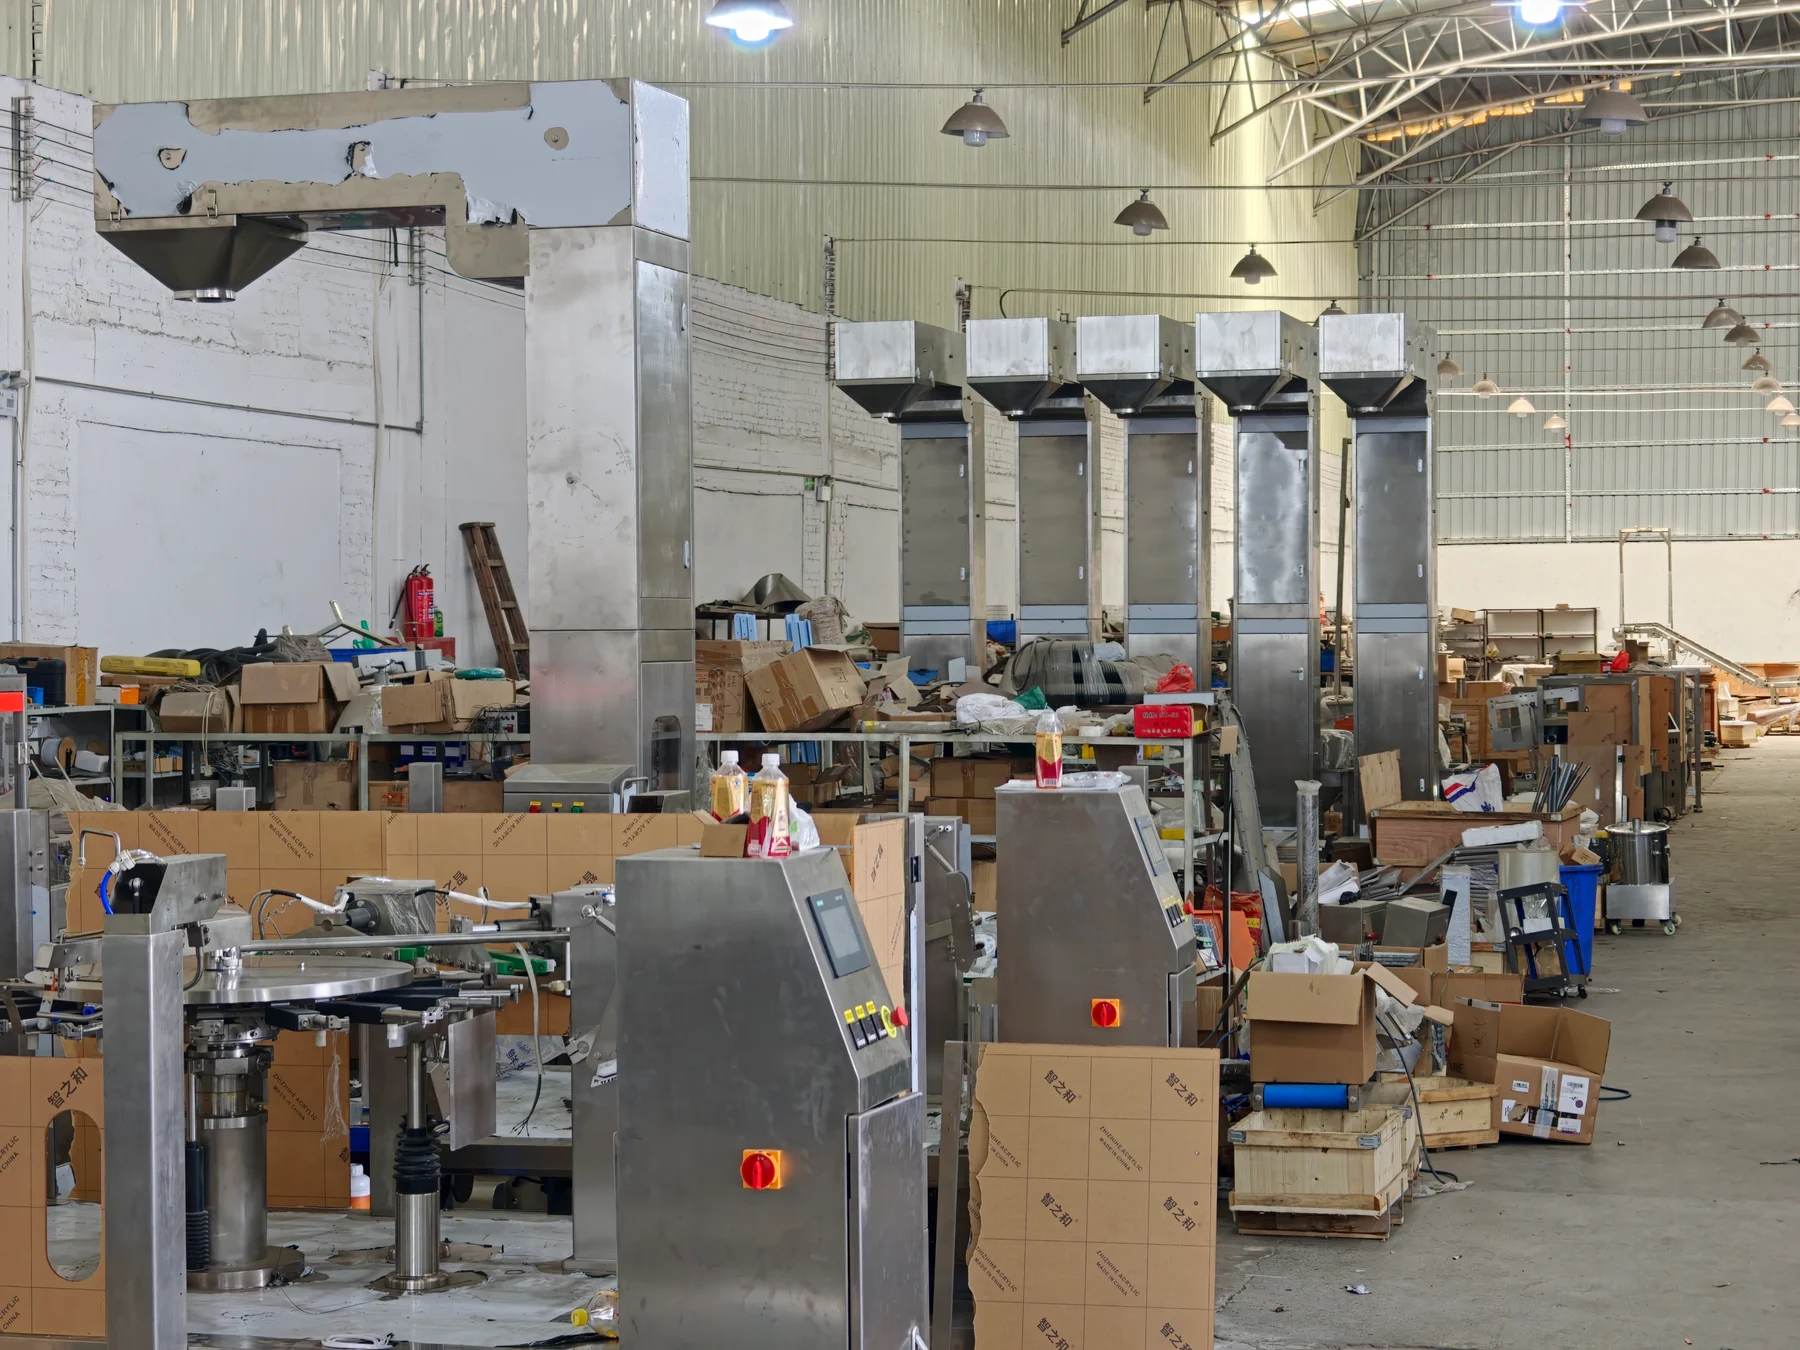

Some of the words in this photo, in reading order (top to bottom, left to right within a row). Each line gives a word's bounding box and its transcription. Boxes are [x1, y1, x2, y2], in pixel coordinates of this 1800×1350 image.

[148, 812, 171, 837] ZHIZHIHE
[170, 835, 191, 855] ACRYLI
[148, 823, 161, 839] MADE
[166, 842, 180, 855] CHIN
[269, 812, 292, 837] ZHIZHIHE
[291, 835, 314, 858] ACRYLIC
[269, 823, 282, 839] MADE
[286, 842, 301, 858] CHINA
[493, 818, 509, 834] CHINA
[493, 823, 516, 848] ACRYLIC
[623, 818, 639, 834] CHINA
[623, 824, 646, 848] ACRYLIC
[47, 1066, 88, 1109] 智之和
[273, 1073, 296, 1099] ZHIZHIHE
[295, 1097, 318, 1121] ACRYLIC
[273, 1085, 286, 1101] MADE
[290, 1105, 305, 1121] CHINA
[1044, 1069, 1077, 1104] 智之和
[1165, 1072, 1198, 1107] 智之和
[0, 1135, 19, 1159] RYLIC
[1, 1151, 19, 1170] CHINA
[995, 1151, 1009, 1168] CHINA
[1000, 1145, 1022, 1168] ACRYLIC
[1099, 1125, 1122, 1150] ZHIZHIHE
[1121, 1149, 1143, 1171] ACRYLIC
[1099, 1137, 1112, 1152] MADE
[1116, 1155, 1131, 1171] CHINA
[1040, 1192, 1073, 1227] 智之和
[1162, 1196, 1196, 1231] 智之和
[975, 1257, 988, 1272] MADE
[986, 1270, 992, 1278] IN
[991, 1276, 1005, 1292] CHINA
[996, 1269, 1018, 1292] ACRYLIC
[1096, 1250, 1119, 1274] ZHIZHIHE
[1118, 1273, 1140, 1297] ACRYLIC
[1096, 1261, 1110, 1277] MADE
[1113, 1280, 1128, 1297] CHINA
[2, 1311, 20, 1330] CHINA
[1036, 1317, 1070, 1350] 智之和
